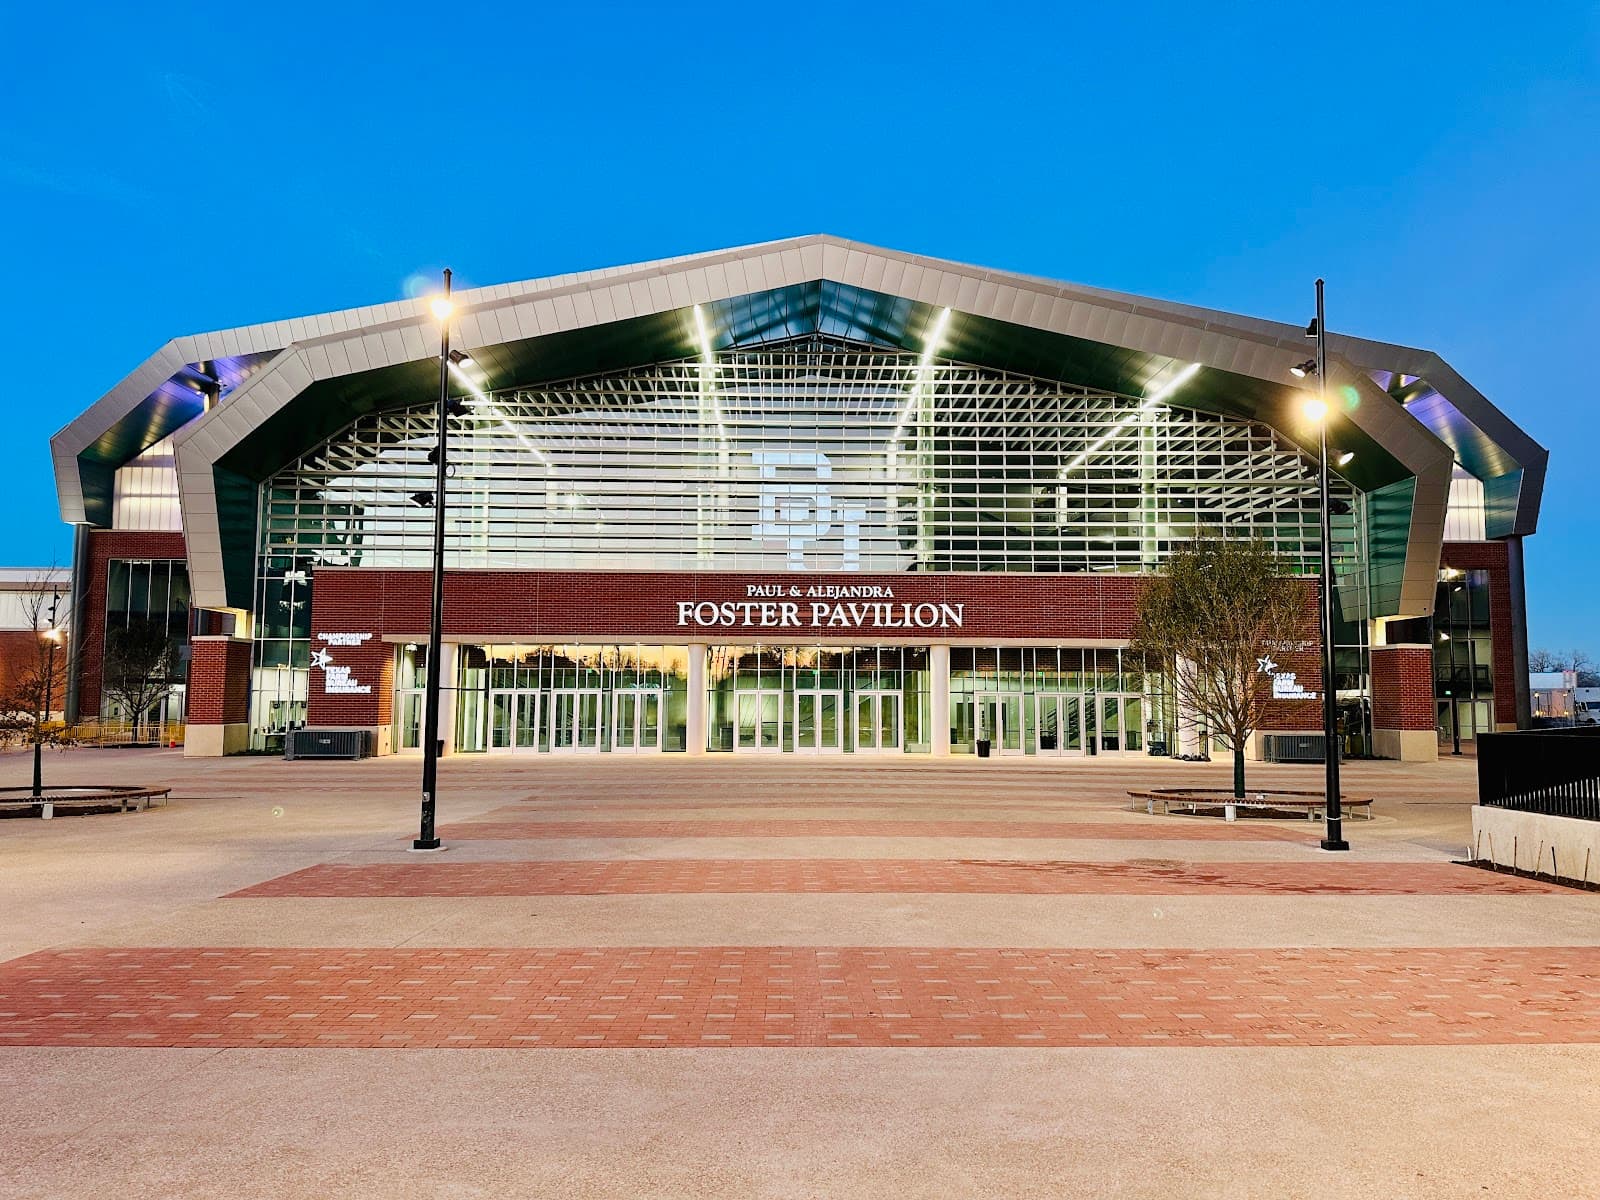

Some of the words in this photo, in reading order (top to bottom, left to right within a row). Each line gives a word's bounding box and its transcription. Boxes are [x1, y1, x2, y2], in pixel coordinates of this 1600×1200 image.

[747, 584, 786, 598] PAUL
[789, 585, 803, 598] &
[806, 585, 894, 599] ALEJANDRA
[676, 601, 802, 627] FOSTER
[810, 602, 964, 628] PAVILION
[325, 666, 351, 674] TEXAS
